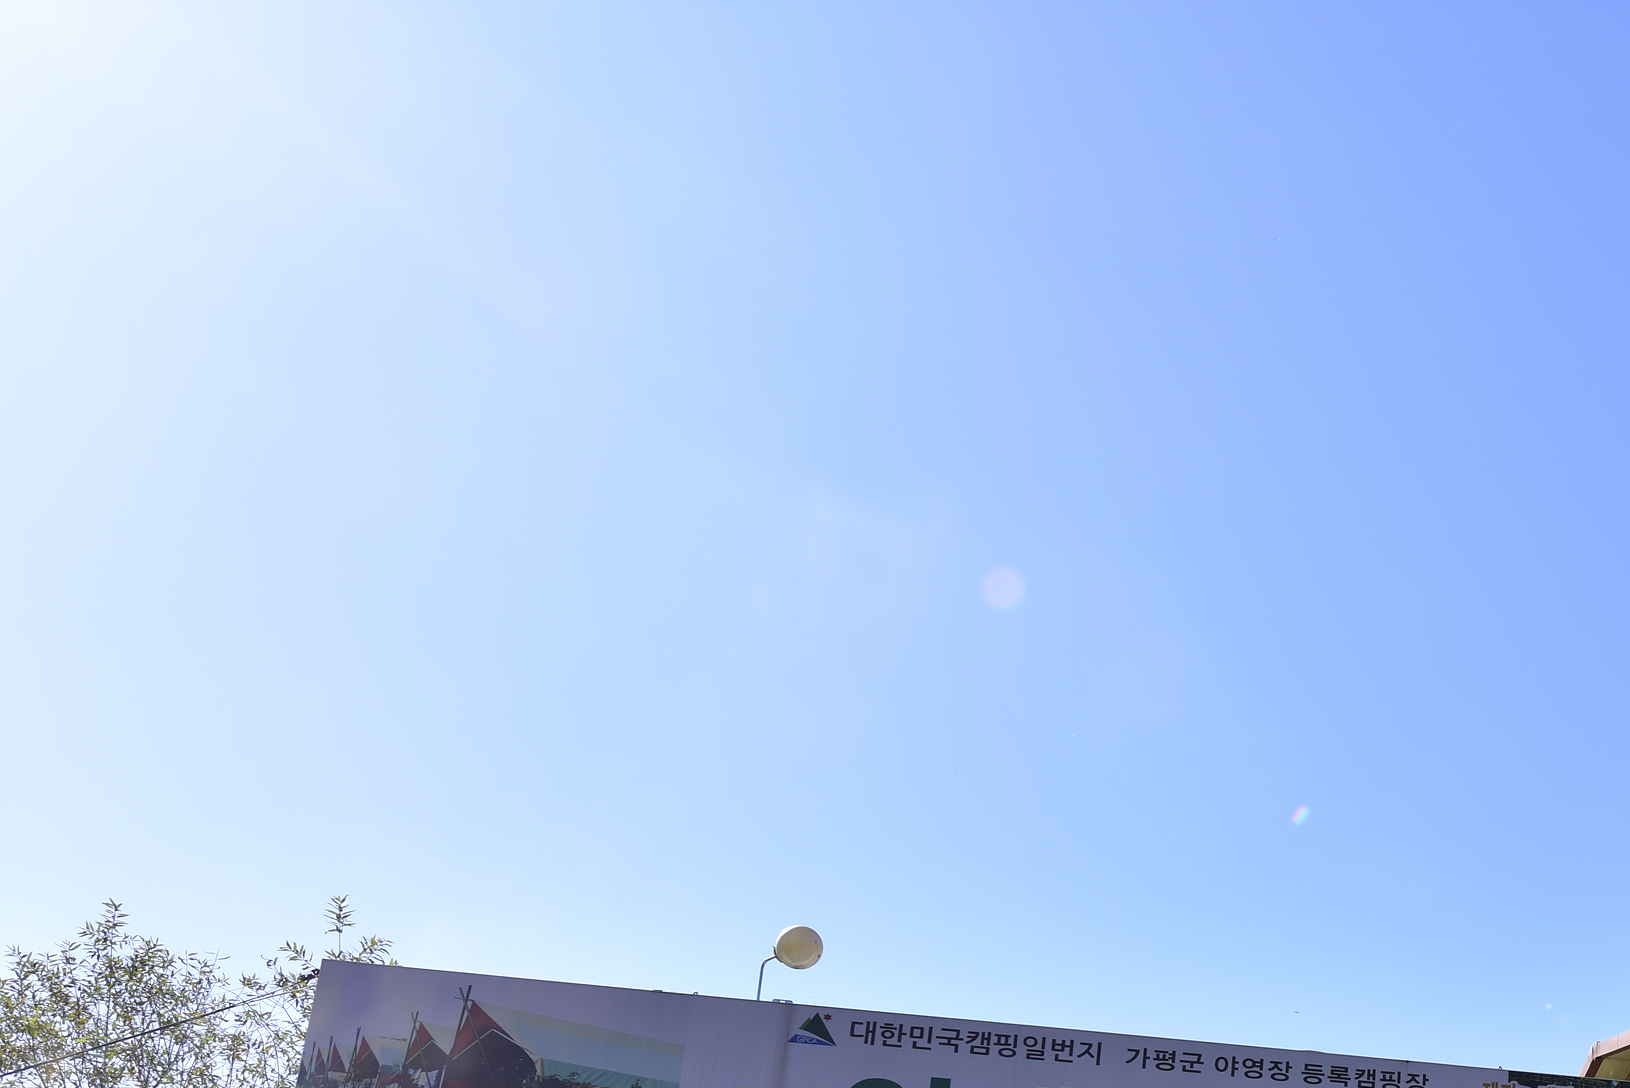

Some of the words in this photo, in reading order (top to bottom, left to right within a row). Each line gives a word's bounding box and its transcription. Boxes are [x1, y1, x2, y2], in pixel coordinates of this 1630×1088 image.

[850, 1020, 1103, 1066] 대한민국캠핑일번지
[1125, 1047, 1205, 1075] 가평군
[1214, 1054, 1292, 1083] 야영장
